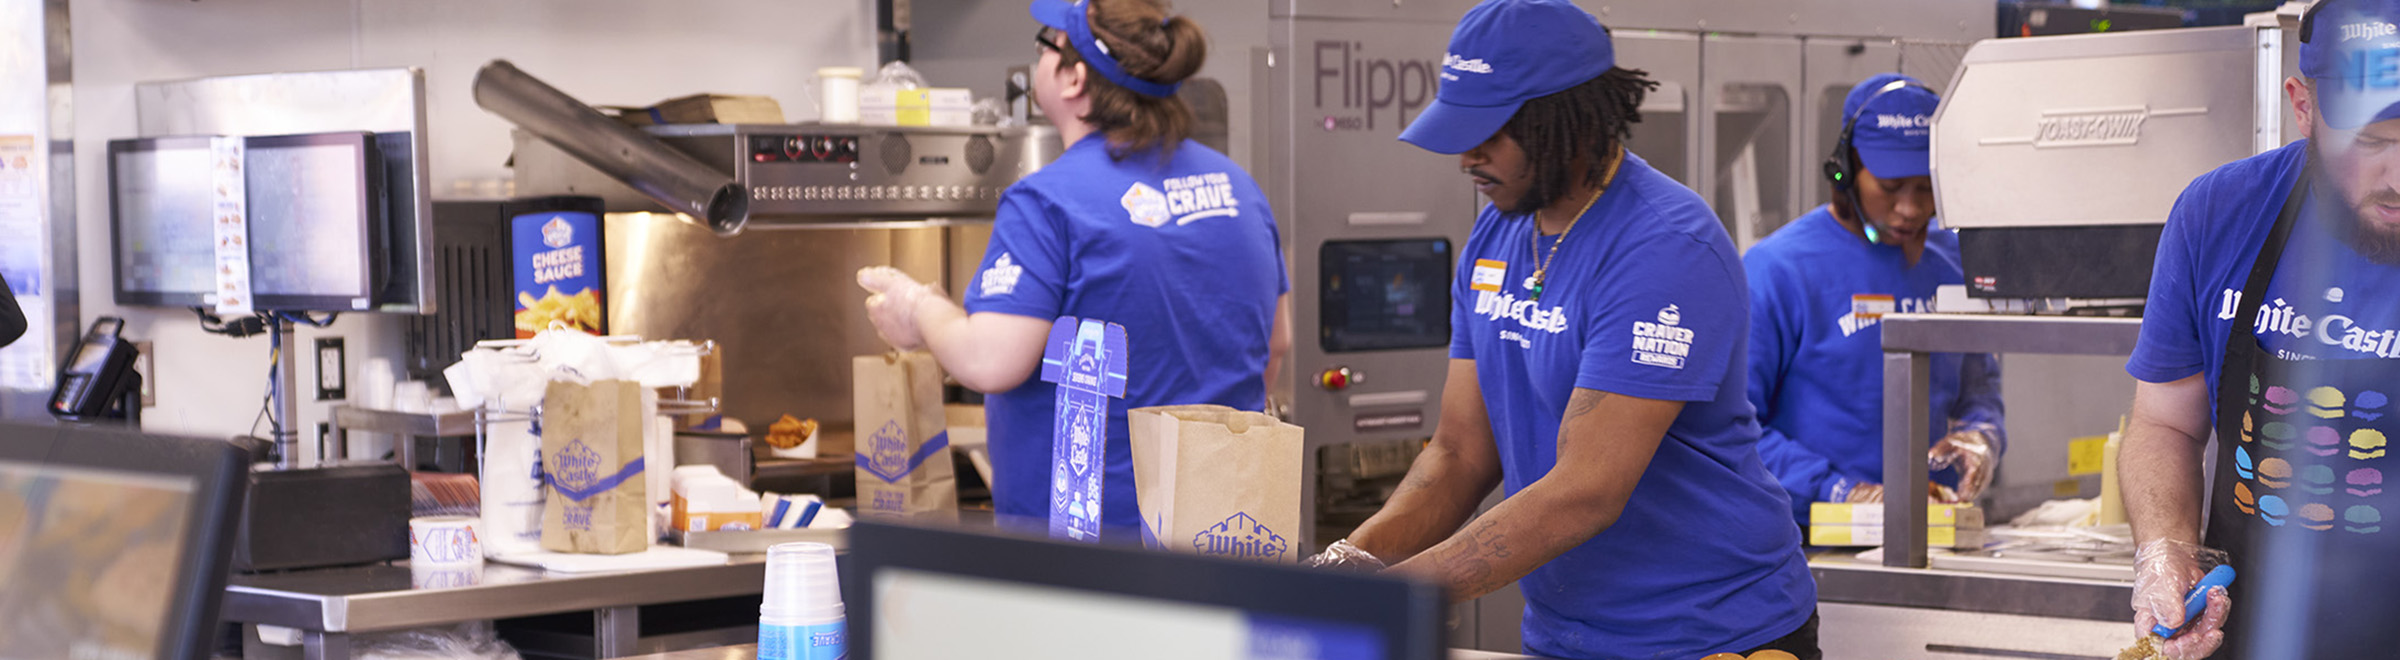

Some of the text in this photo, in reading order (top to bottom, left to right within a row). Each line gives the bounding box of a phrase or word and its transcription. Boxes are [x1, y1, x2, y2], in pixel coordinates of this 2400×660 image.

[2341, 22, 2397, 42] White
[2037, 113, 2146, 142] TOAST-QWIK
[1166, 183, 1238, 215] CRAVE
[533, 245, 582, 269] CHEESE
[534, 262, 583, 284] SAUCE
[1632, 321, 1694, 344] CRAVER
[1632, 336, 1690, 358] NATION
[559, 452, 595, 469] White
[557, 467, 598, 485] Castle
[562, 512, 592, 526] CRAVE
[1206, 533, 1277, 559] White
